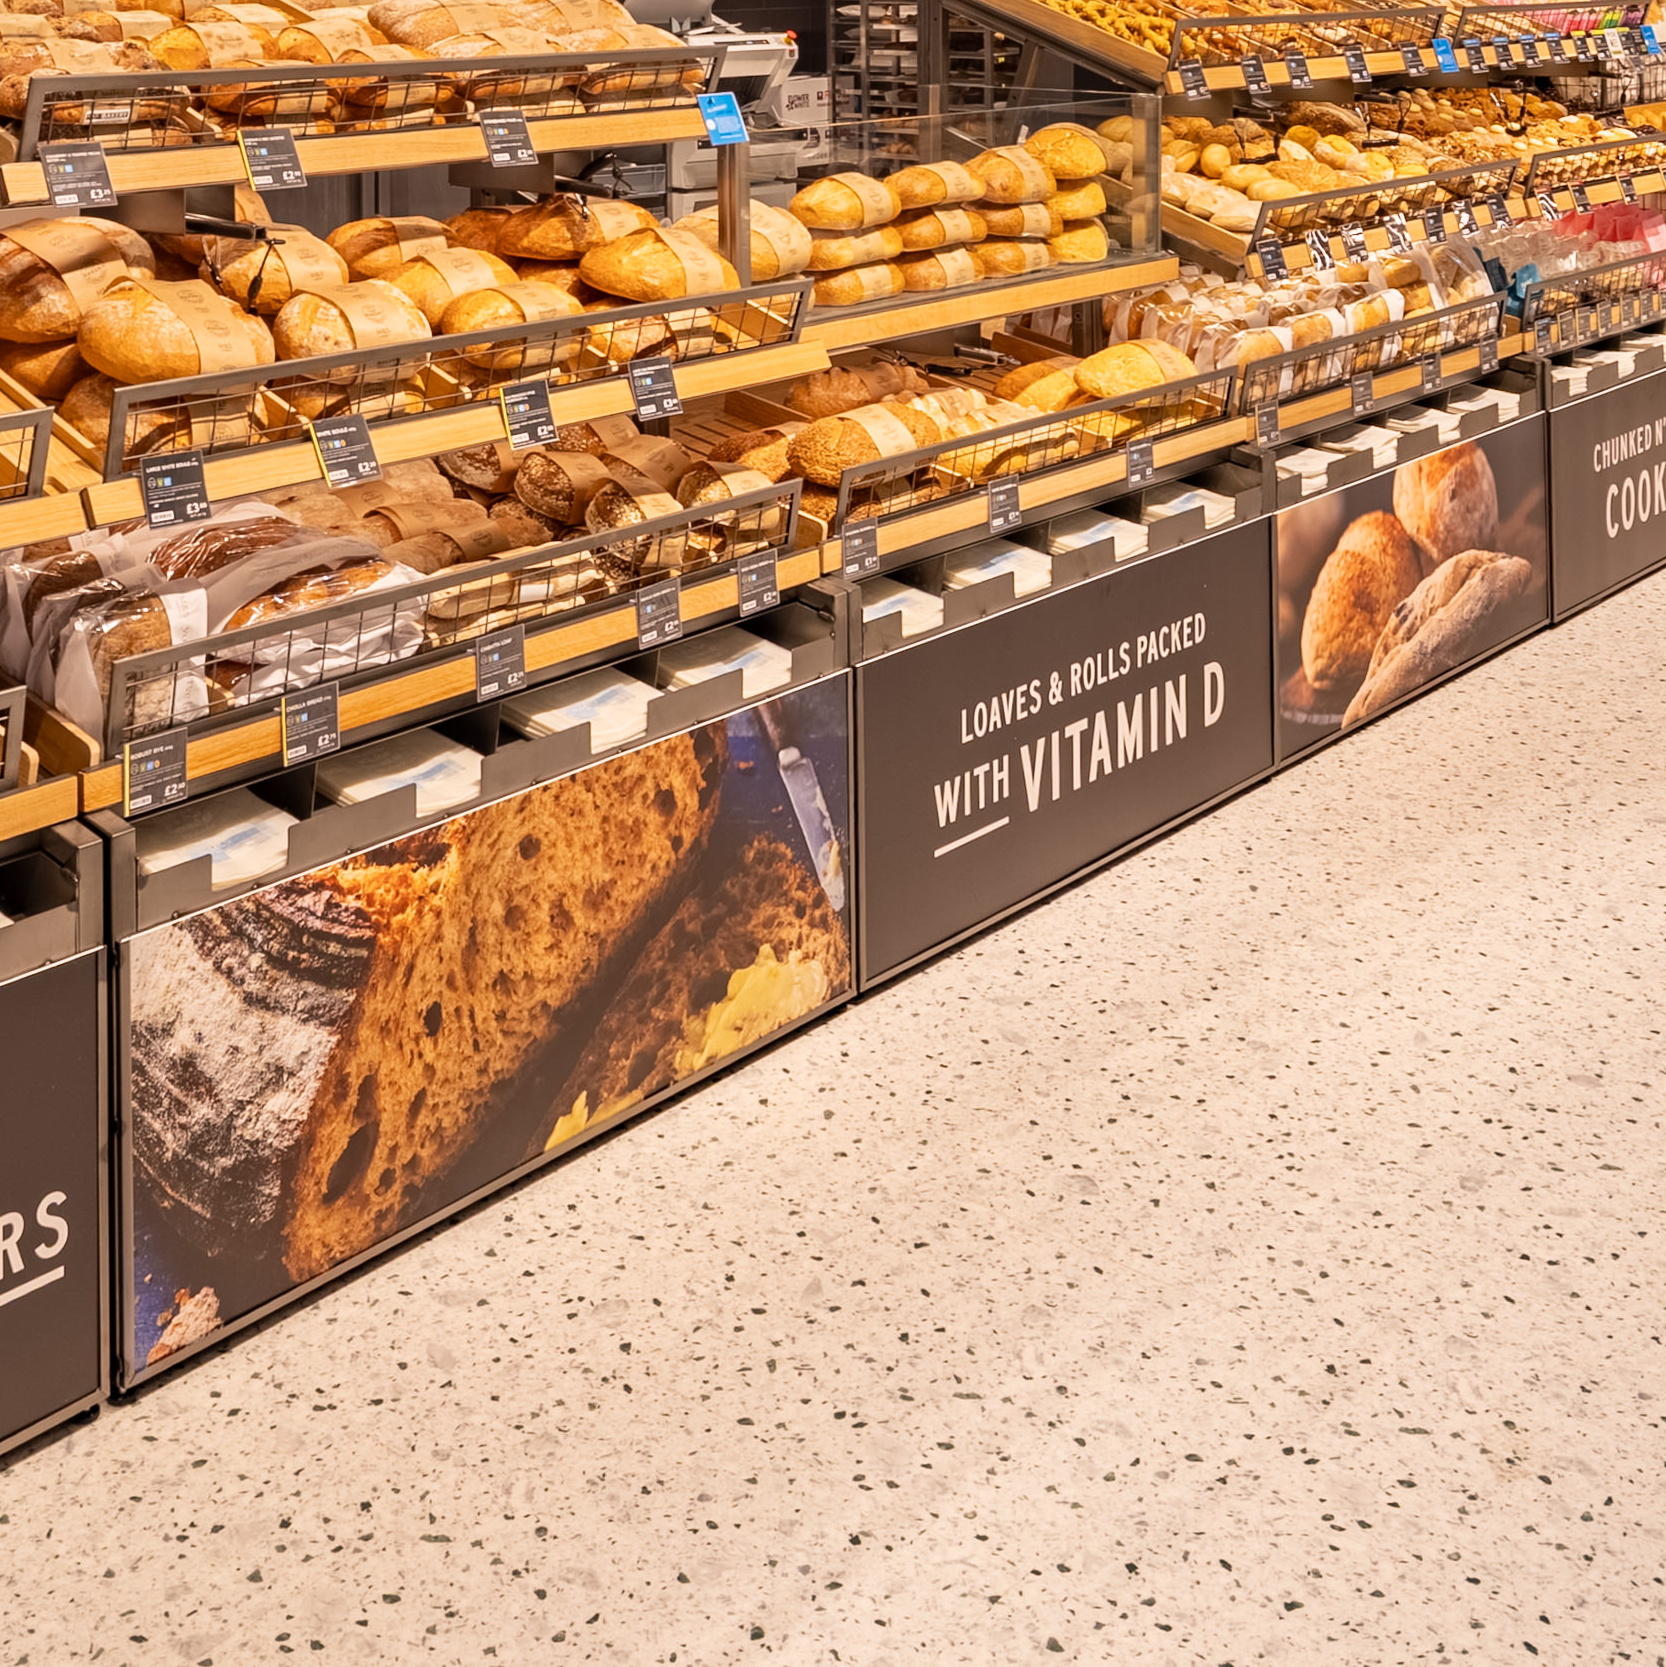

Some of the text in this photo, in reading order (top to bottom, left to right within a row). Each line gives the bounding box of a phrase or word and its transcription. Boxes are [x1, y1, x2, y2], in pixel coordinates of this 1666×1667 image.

[1593, 424, 1652, 473] CHUNKED
[1655, 417, 1666, 446] N'
[286, 697, 323, 712] CHOLLA BREAD
[961, 612, 1206, 744] LOAVES & ROLLS PACKED
[131, 746, 164, 761] ROBUST RYE
[934, 661, 1226, 828] WITH VITAMIN D
